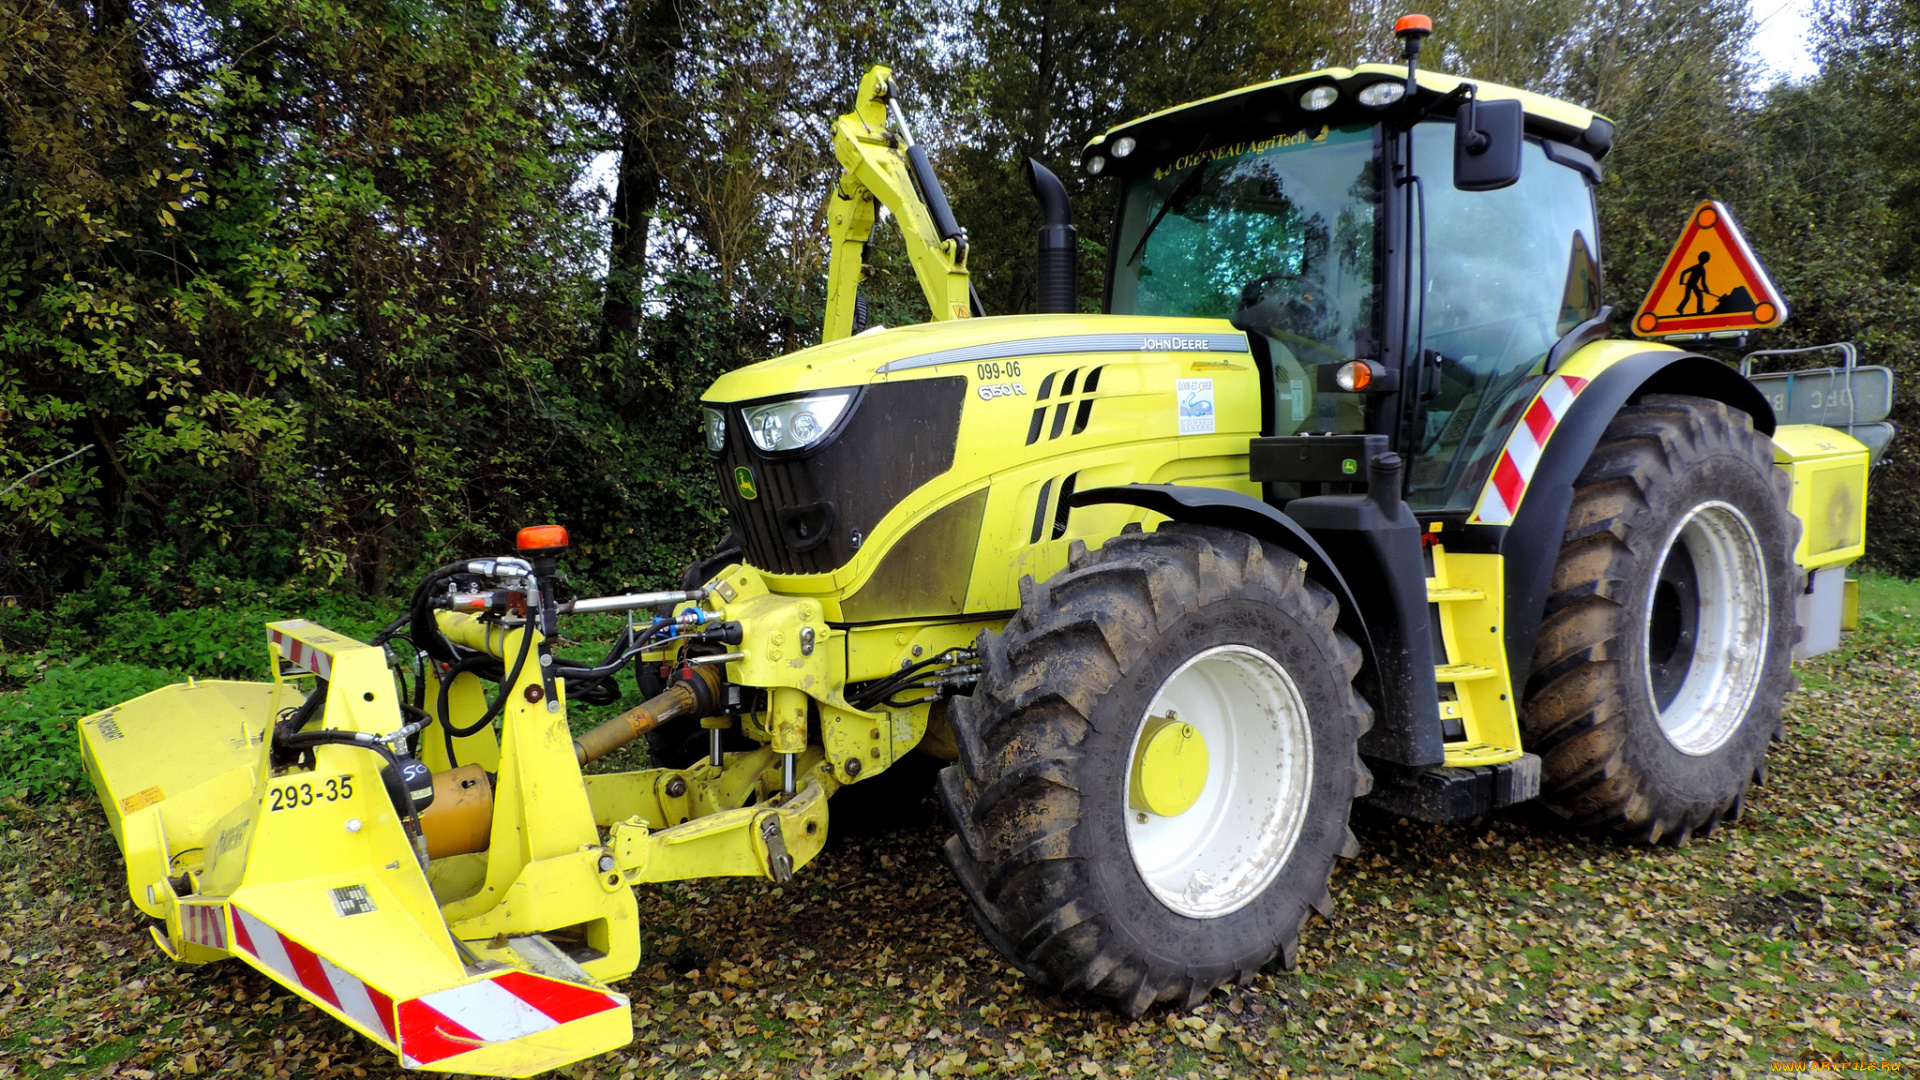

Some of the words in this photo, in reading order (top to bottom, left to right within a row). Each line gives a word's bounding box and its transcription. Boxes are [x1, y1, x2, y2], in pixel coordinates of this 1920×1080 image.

[1247, 130, 1306, 154] AgriTech
[977, 361, 1021, 380] 099-06
[270, 777, 353, 812] 293-35
